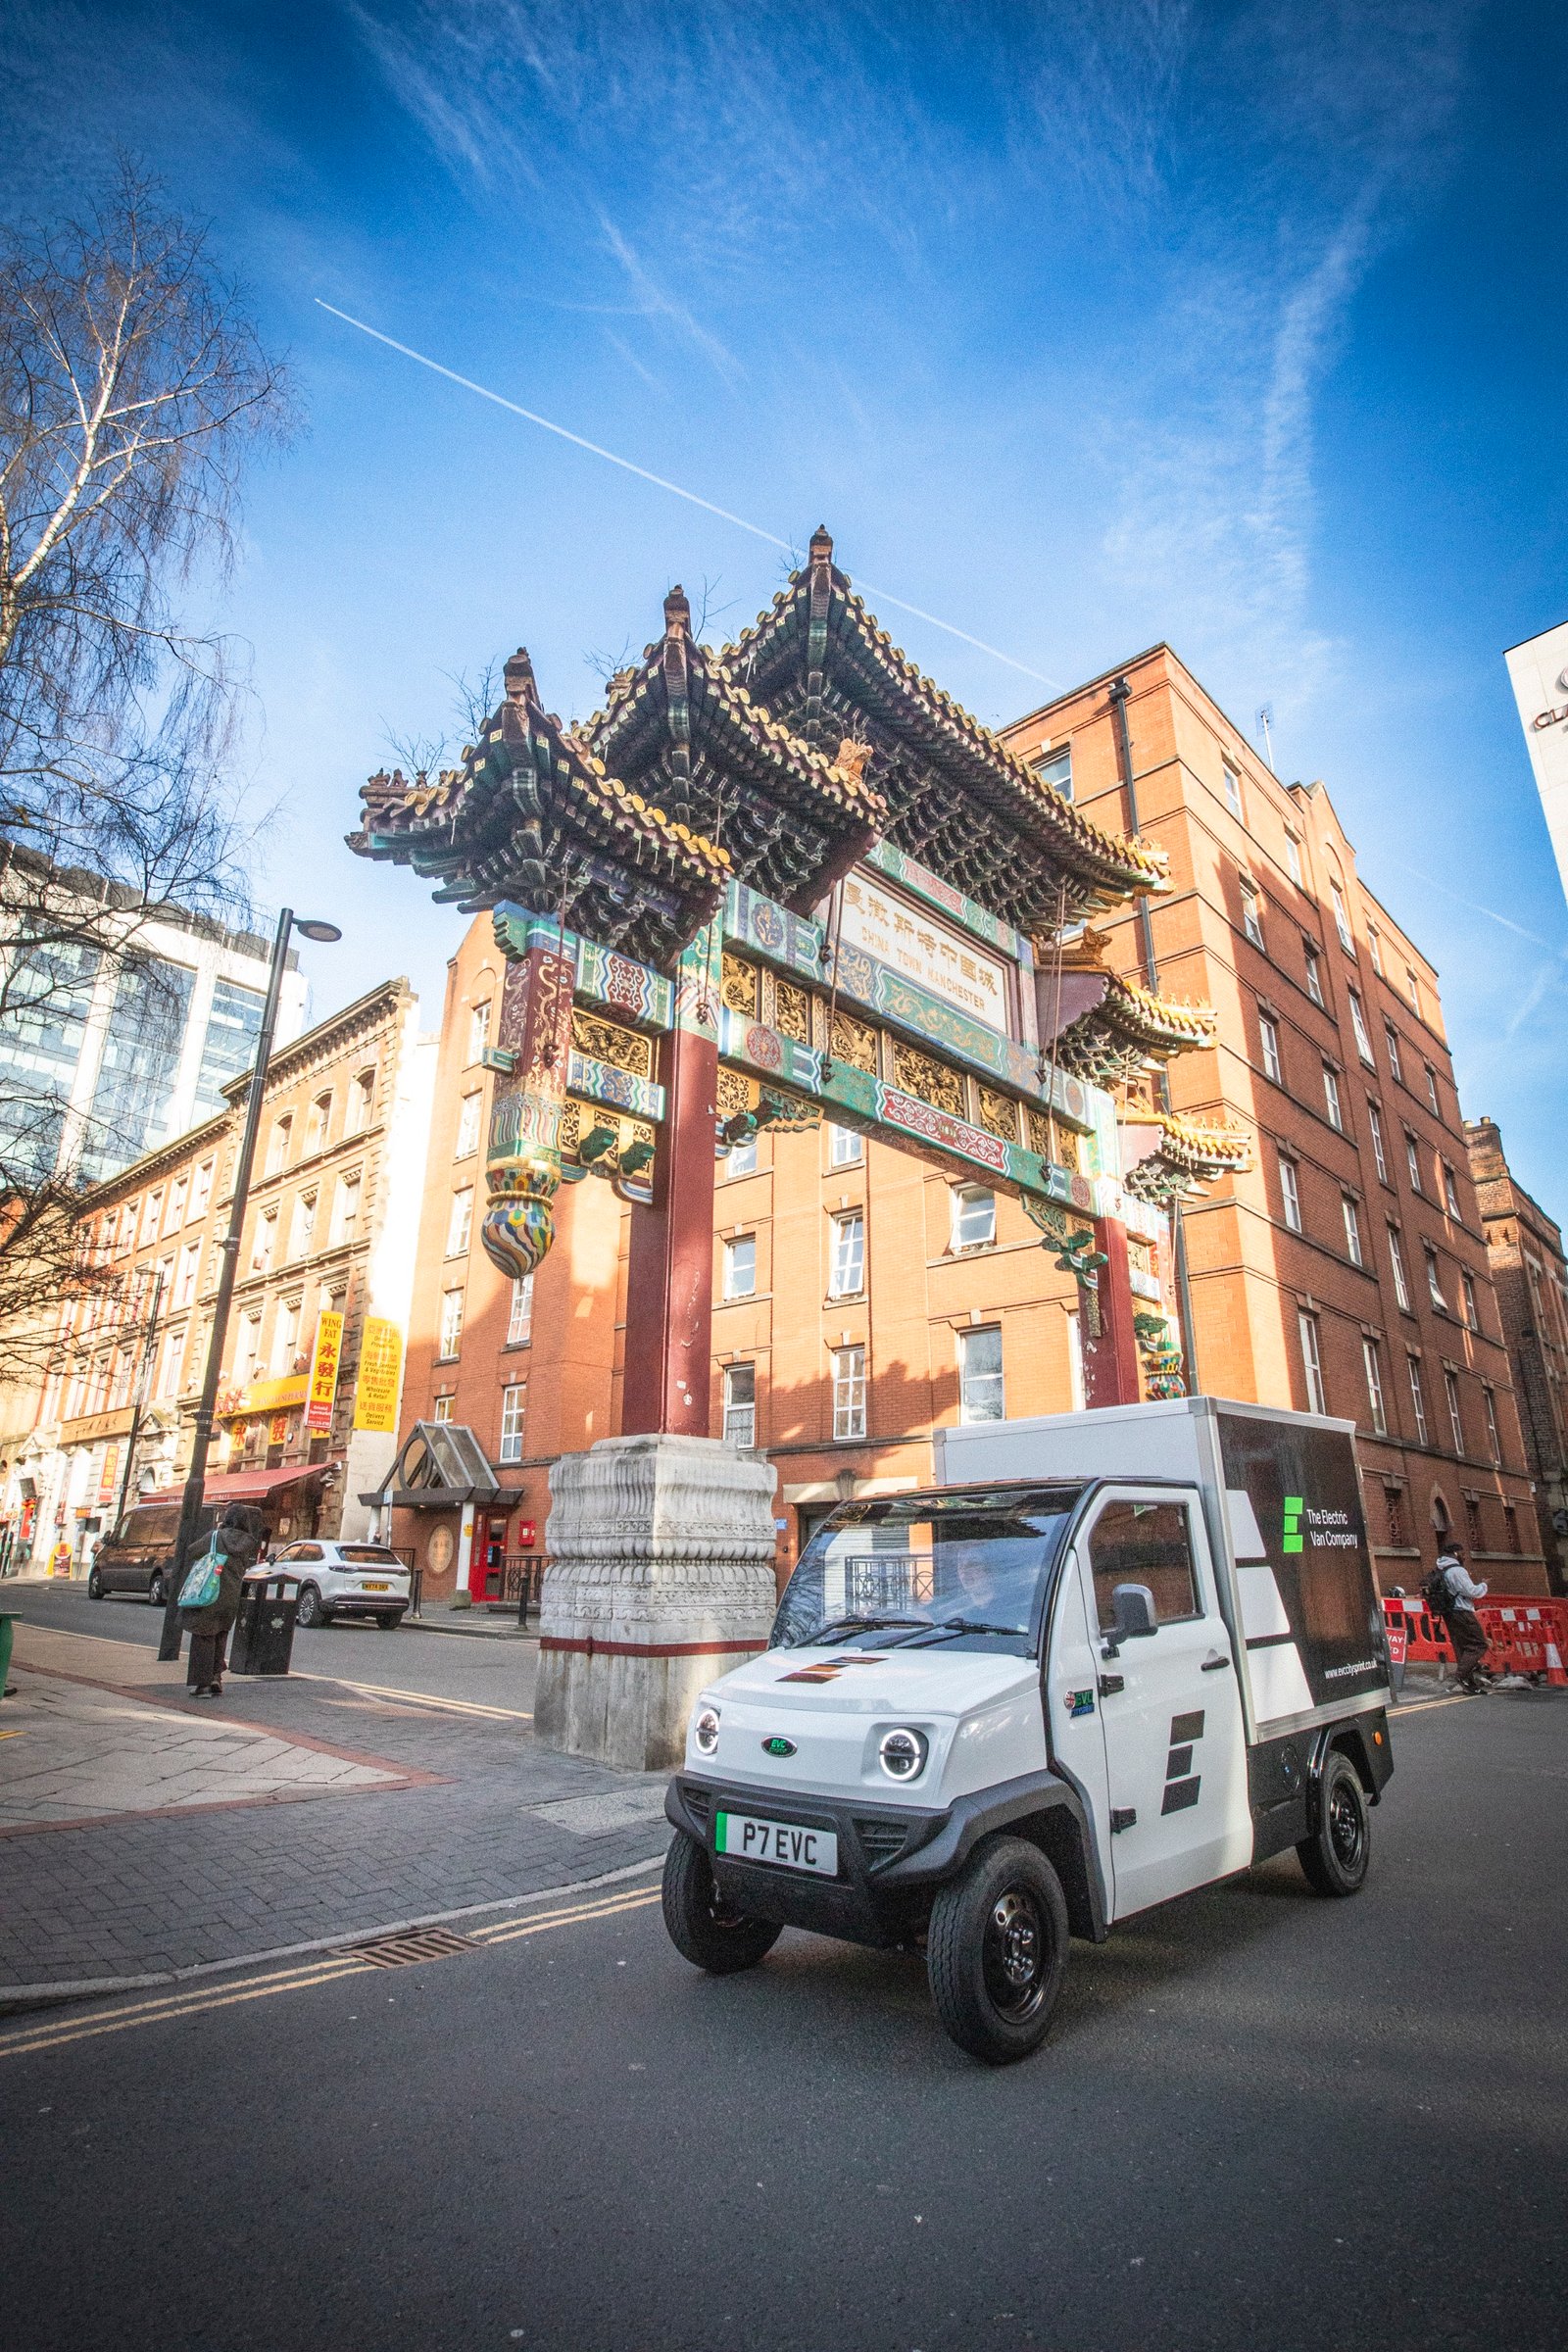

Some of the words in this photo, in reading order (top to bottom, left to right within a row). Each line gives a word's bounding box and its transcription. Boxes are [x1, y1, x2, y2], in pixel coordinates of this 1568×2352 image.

[861, 926, 889, 953] CHINA
[897, 947, 922, 974] TOWN
[927, 965, 986, 1010] MANCHESTER
[320, 1317, 342, 1329] WING
[324, 1328, 337, 1339] FAT
[315, 1342, 336, 1396] 永發行
[366, 1412, 385, 1421] Delivery
[1306, 1509, 1321, 1525] The
[1321, 1509, 1348, 1525] Electric
[1310, 1531, 1326, 1546] Van
[1325, 1531, 1358, 1548] Company
[1075, 1690, 1093, 1706] EVC
[771, 1739, 786, 1748] EVC
[743, 1822, 770, 1855] P7
[776, 1829, 817, 1865] EVC
